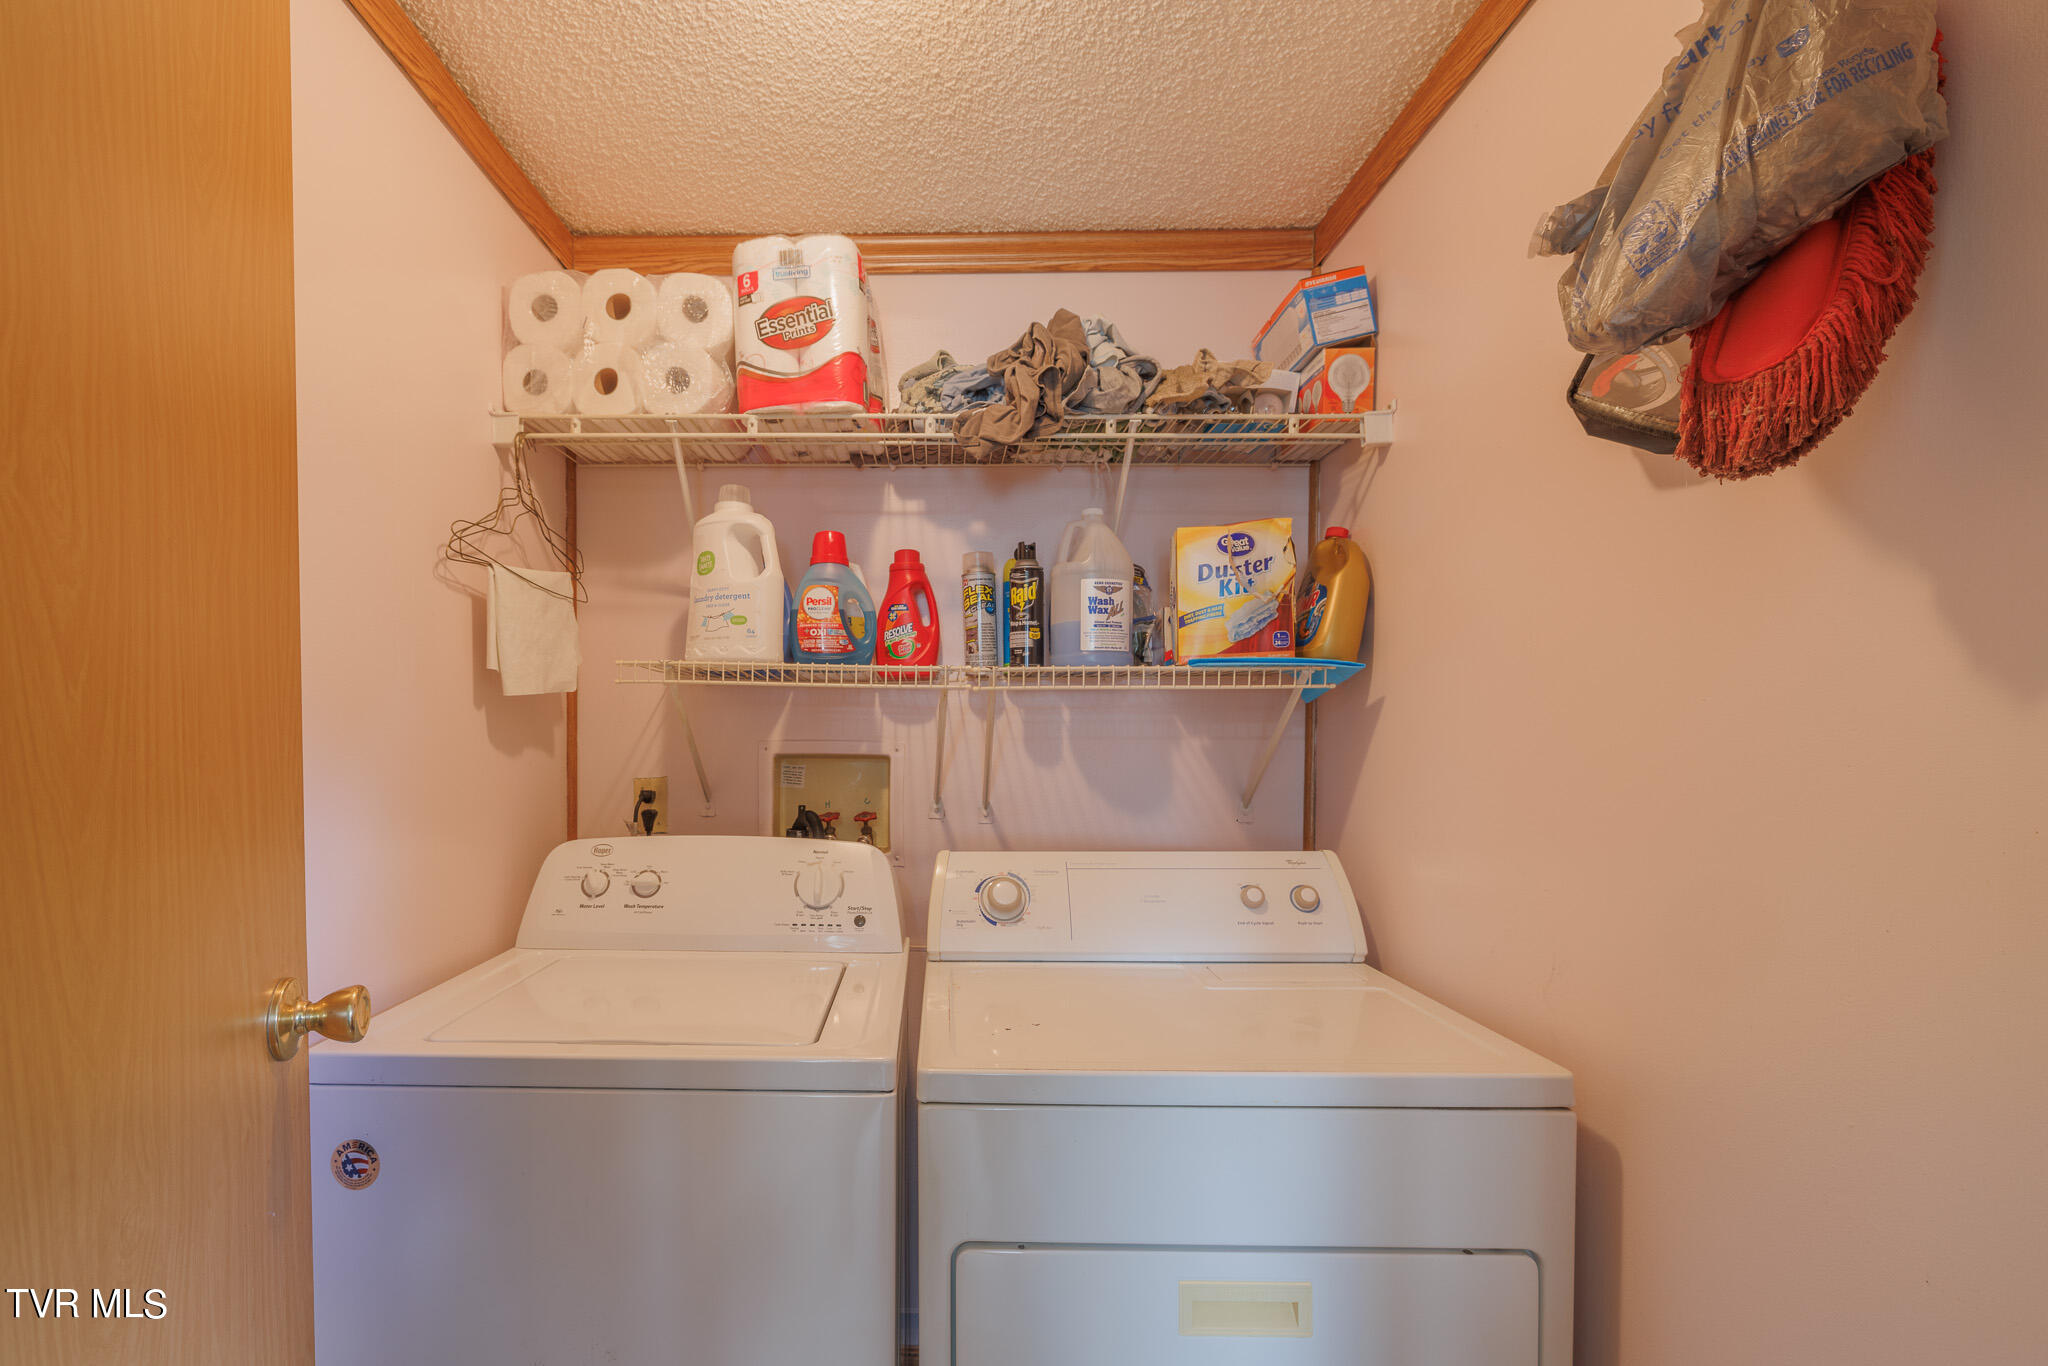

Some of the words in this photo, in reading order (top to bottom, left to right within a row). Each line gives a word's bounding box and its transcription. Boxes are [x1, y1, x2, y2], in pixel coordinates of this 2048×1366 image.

[1675, 24, 1724, 71] art
[1823, 70, 1852, 98] FOR
[742, 273, 751, 288] 6
[756, 300, 834, 338] Essential
[783, 325, 816, 341] Prints
[806, 596, 832, 606] Persil
[962, 584, 993, 599] FLEX
[1010, 581, 1037, 606] Raid
[1087, 596, 1115, 606] Wash
[963, 593, 993, 612] SEAL
[1087, 605, 1109, 615] Wax
[884, 622, 913, 641] RESOLVE
[335, 1141, 378, 1165] AMERICA
